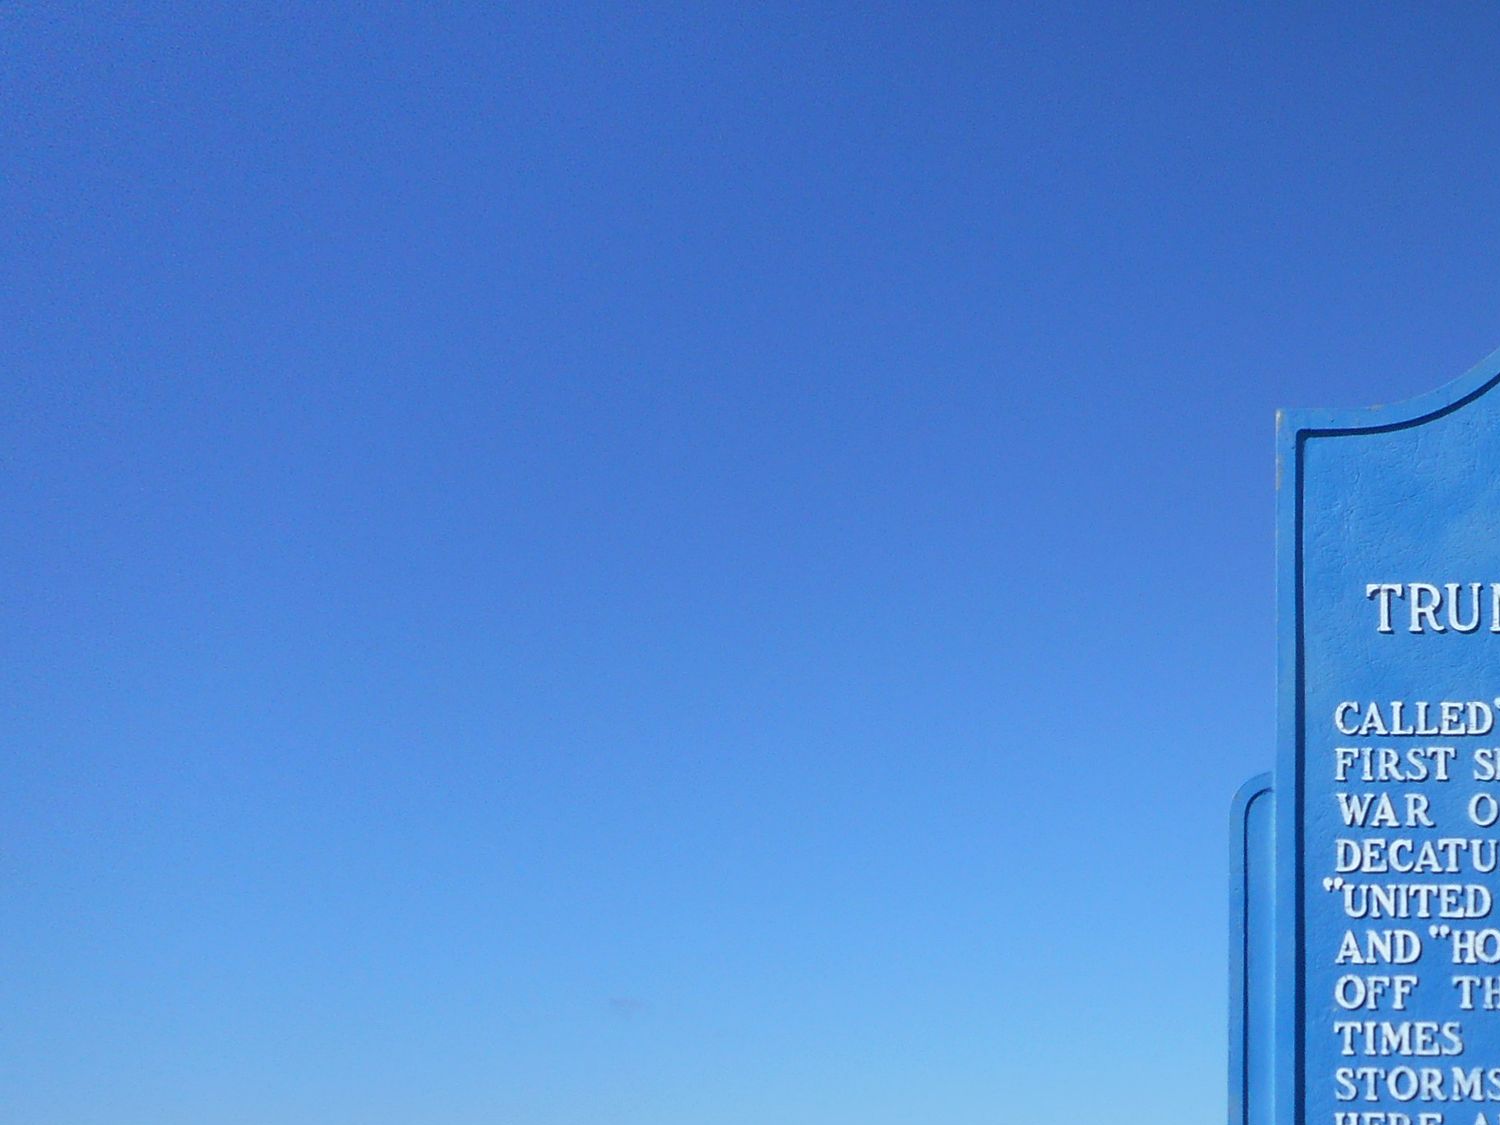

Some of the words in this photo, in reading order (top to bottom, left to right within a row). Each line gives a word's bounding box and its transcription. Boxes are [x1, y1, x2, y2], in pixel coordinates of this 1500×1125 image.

[1334, 700, 1493, 735] CALLED
[1334, 746, 1455, 781] FIRST
[1335, 792, 1434, 827] WAR
[1335, 929, 1421, 964] AND
[1334, 974, 1418, 1010] OFF
[1333, 1021, 1463, 1056] TIMES
